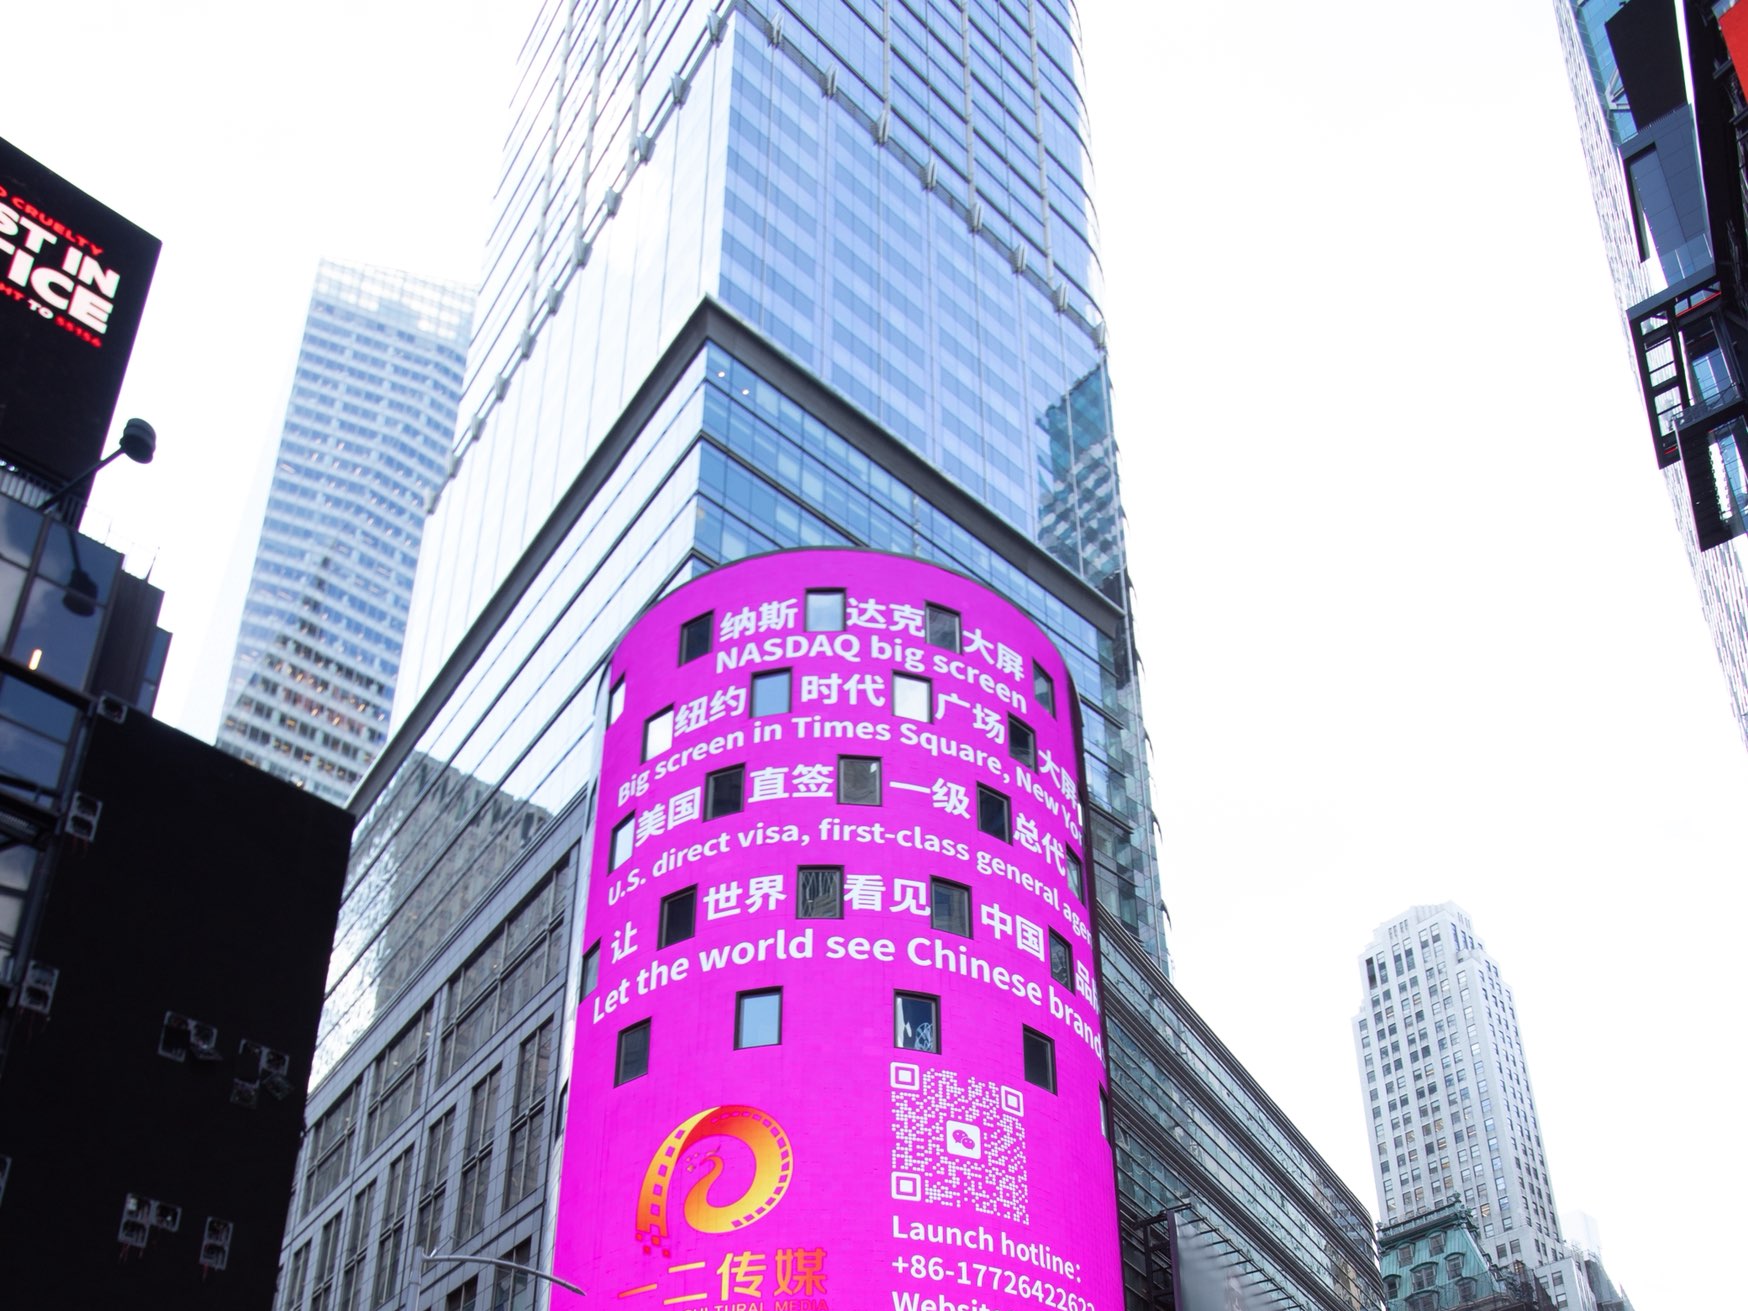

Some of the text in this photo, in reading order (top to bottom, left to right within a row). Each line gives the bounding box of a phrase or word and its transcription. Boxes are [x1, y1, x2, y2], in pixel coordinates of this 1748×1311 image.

[11, 196, 103, 257] CRUELTY
[0, 237, 114, 334] ICE
[27, 298, 54, 319] TO
[62, 246, 120, 299] IN
[716, 634, 1027, 714] NASDAQ big screen
[617, 769, 651, 807] Big
[654, 730, 744, 780] screen
[753, 720, 782, 744] in
[791, 715, 892, 741] Times
[899, 722, 1010, 784] Square,
[1016, 766, 1059, 816] New
[608, 868, 647, 906] U.S.
[652, 832, 731, 878] direct
[738, 822, 810, 846] visa,
[819, 818, 971, 861] first-class
[976, 851, 1060, 912] general
[592, 978, 631, 1025] Let
[636, 957, 690, 996] the
[699, 928, 814, 973] world
[826, 935, 896, 962] see
[906, 937, 1043, 1006] Chinese
[892, 1215, 1082, 1283] Launch hotline:
